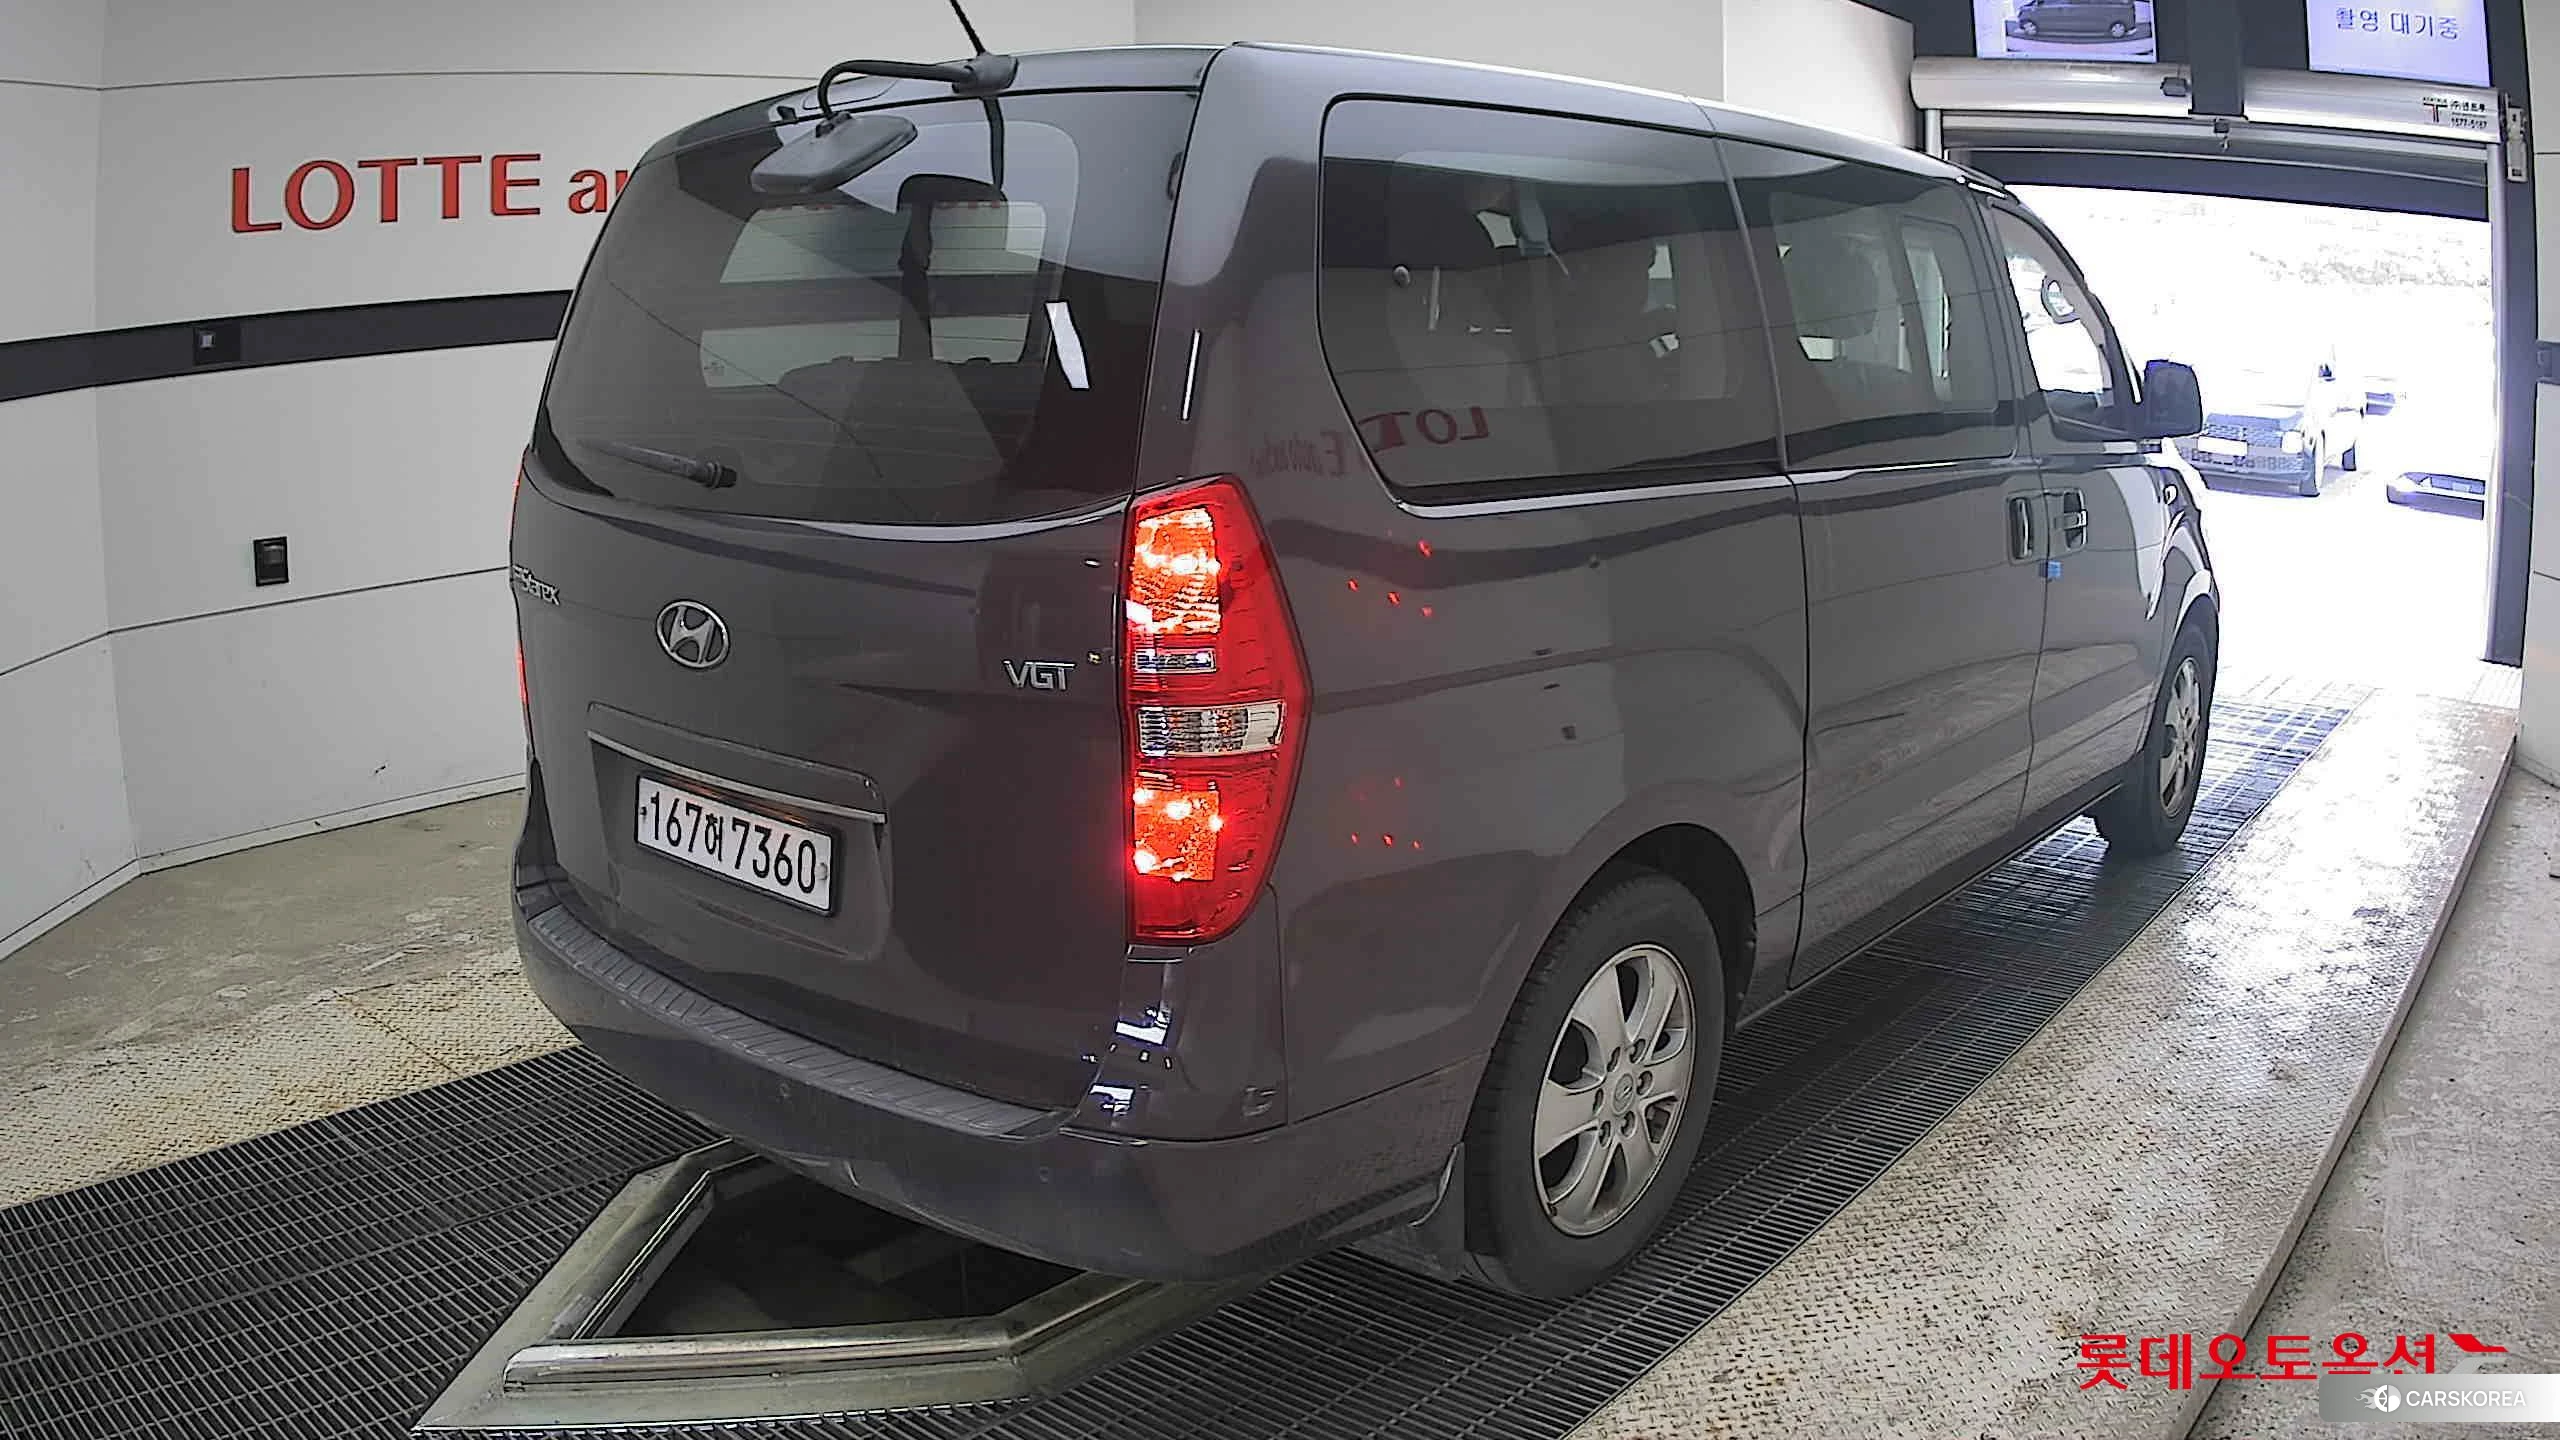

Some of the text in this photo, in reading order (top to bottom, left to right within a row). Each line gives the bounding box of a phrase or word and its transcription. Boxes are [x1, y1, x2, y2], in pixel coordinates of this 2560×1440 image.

[2336, 8, 2458, 40] 촬영 대기중
[232, 153, 542, 233] LOTTE
[1002, 659, 1077, 691] VGT
